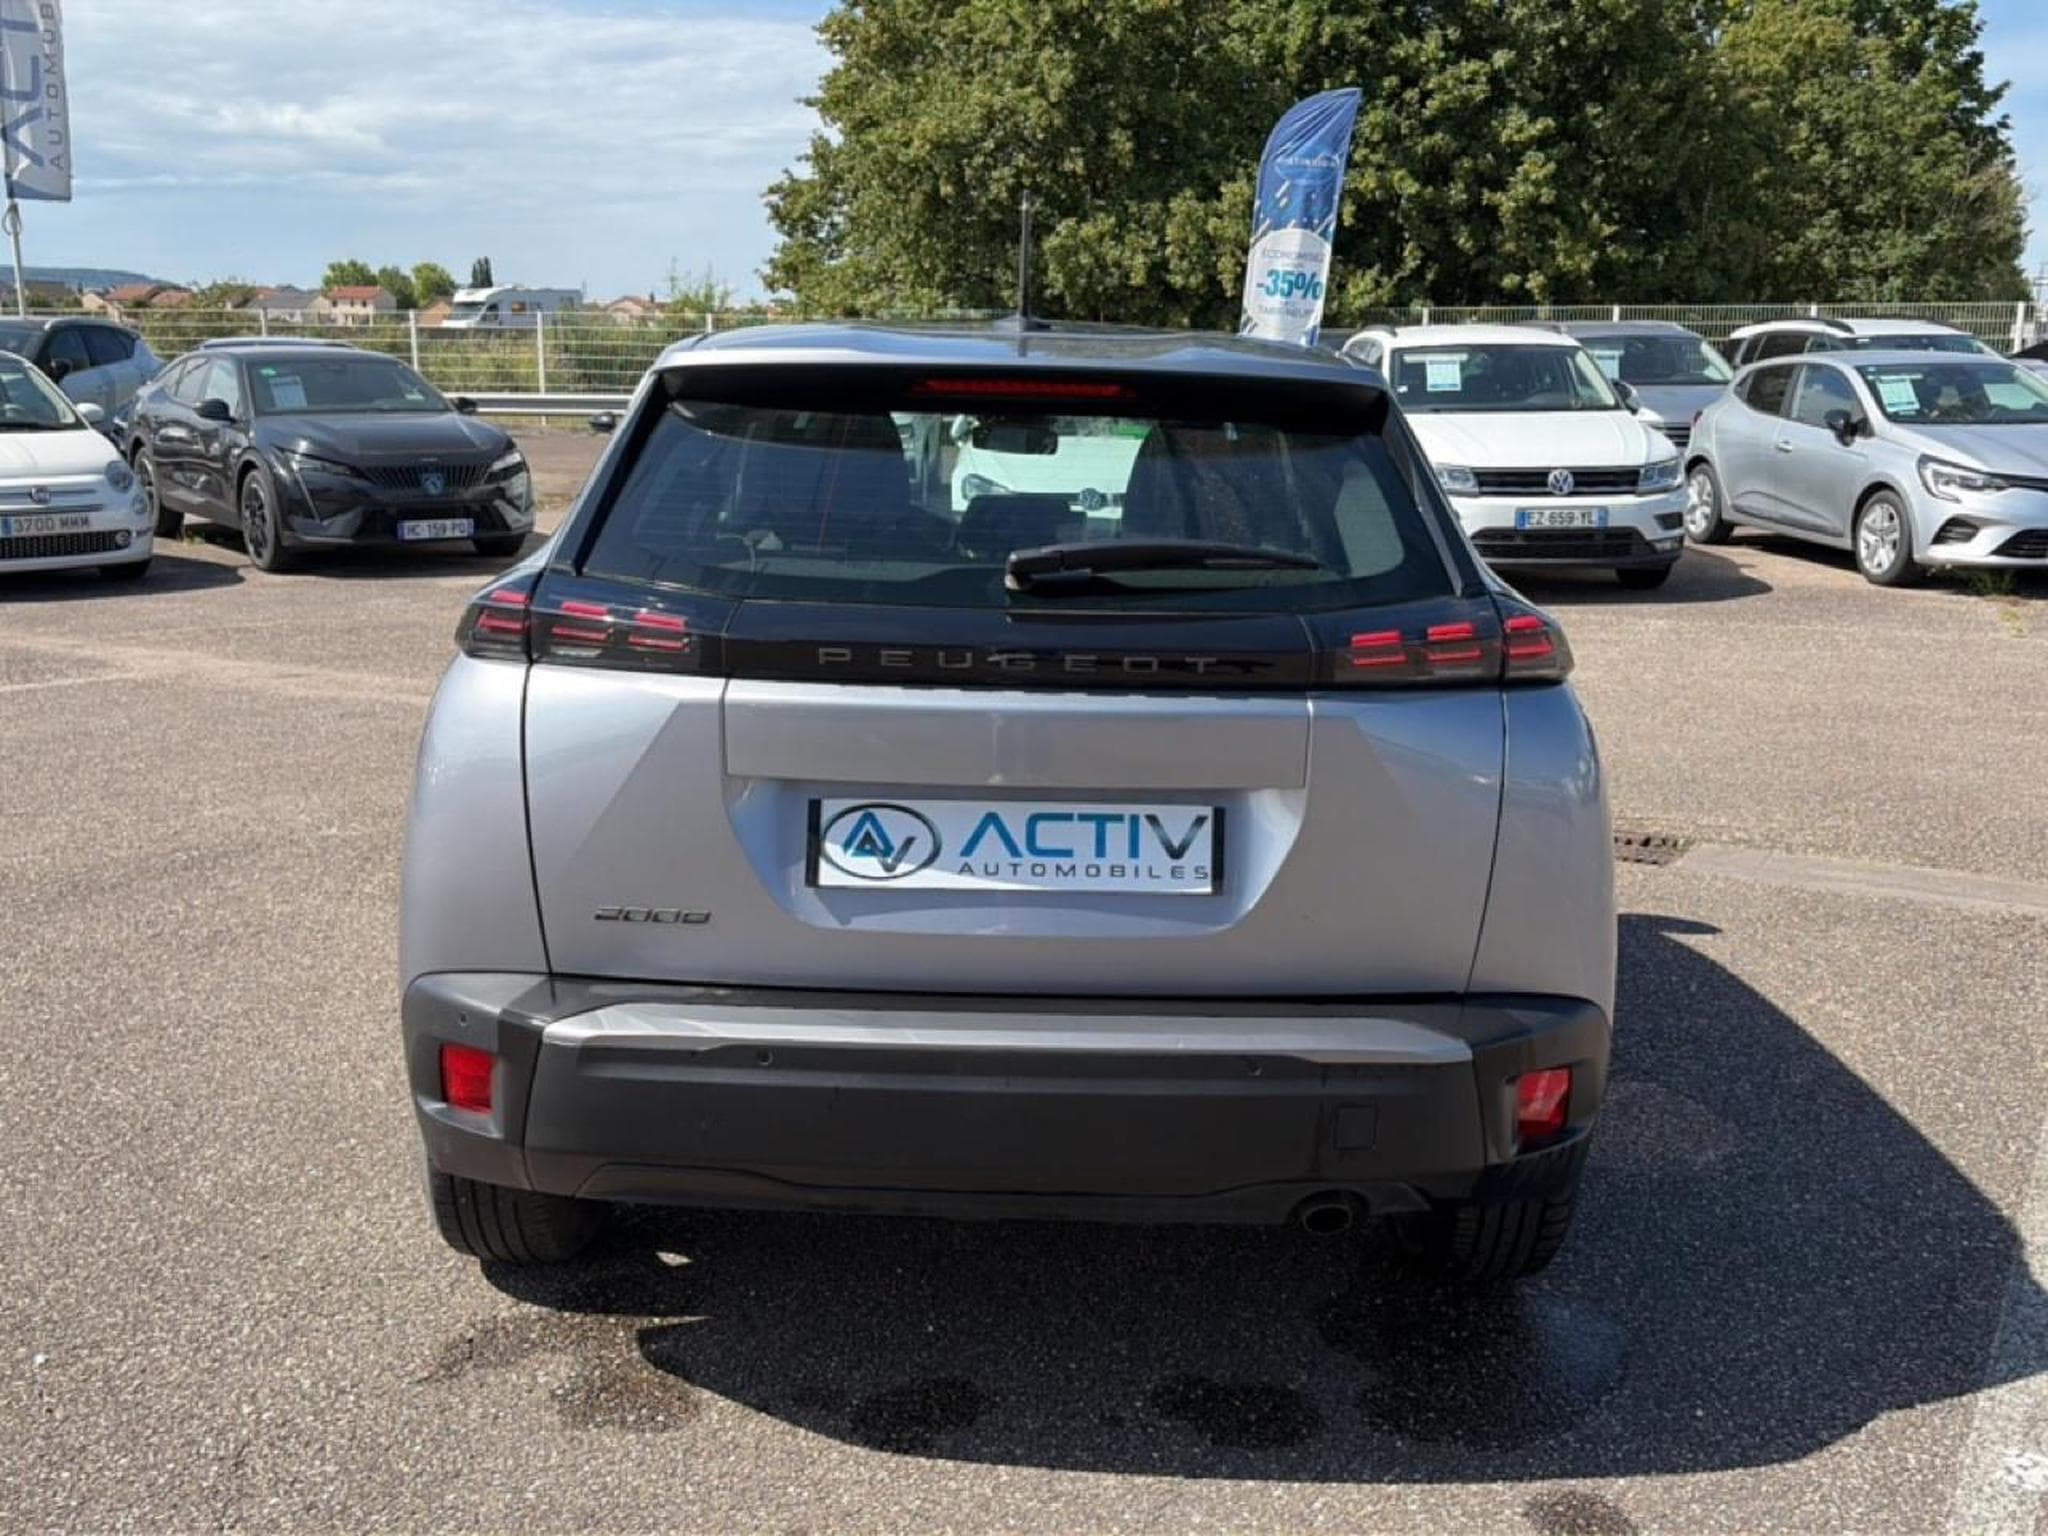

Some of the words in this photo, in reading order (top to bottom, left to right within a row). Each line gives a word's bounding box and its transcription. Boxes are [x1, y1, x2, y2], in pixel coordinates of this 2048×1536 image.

[1256, 269, 1324, 300] -35%
[16, 517, 56, 533] 3700
[818, 646, 1217, 675] PEUGEOT
[959, 811, 1209, 861] ACTIV
[957, 861, 1210, 881] AUTOMOBILES
